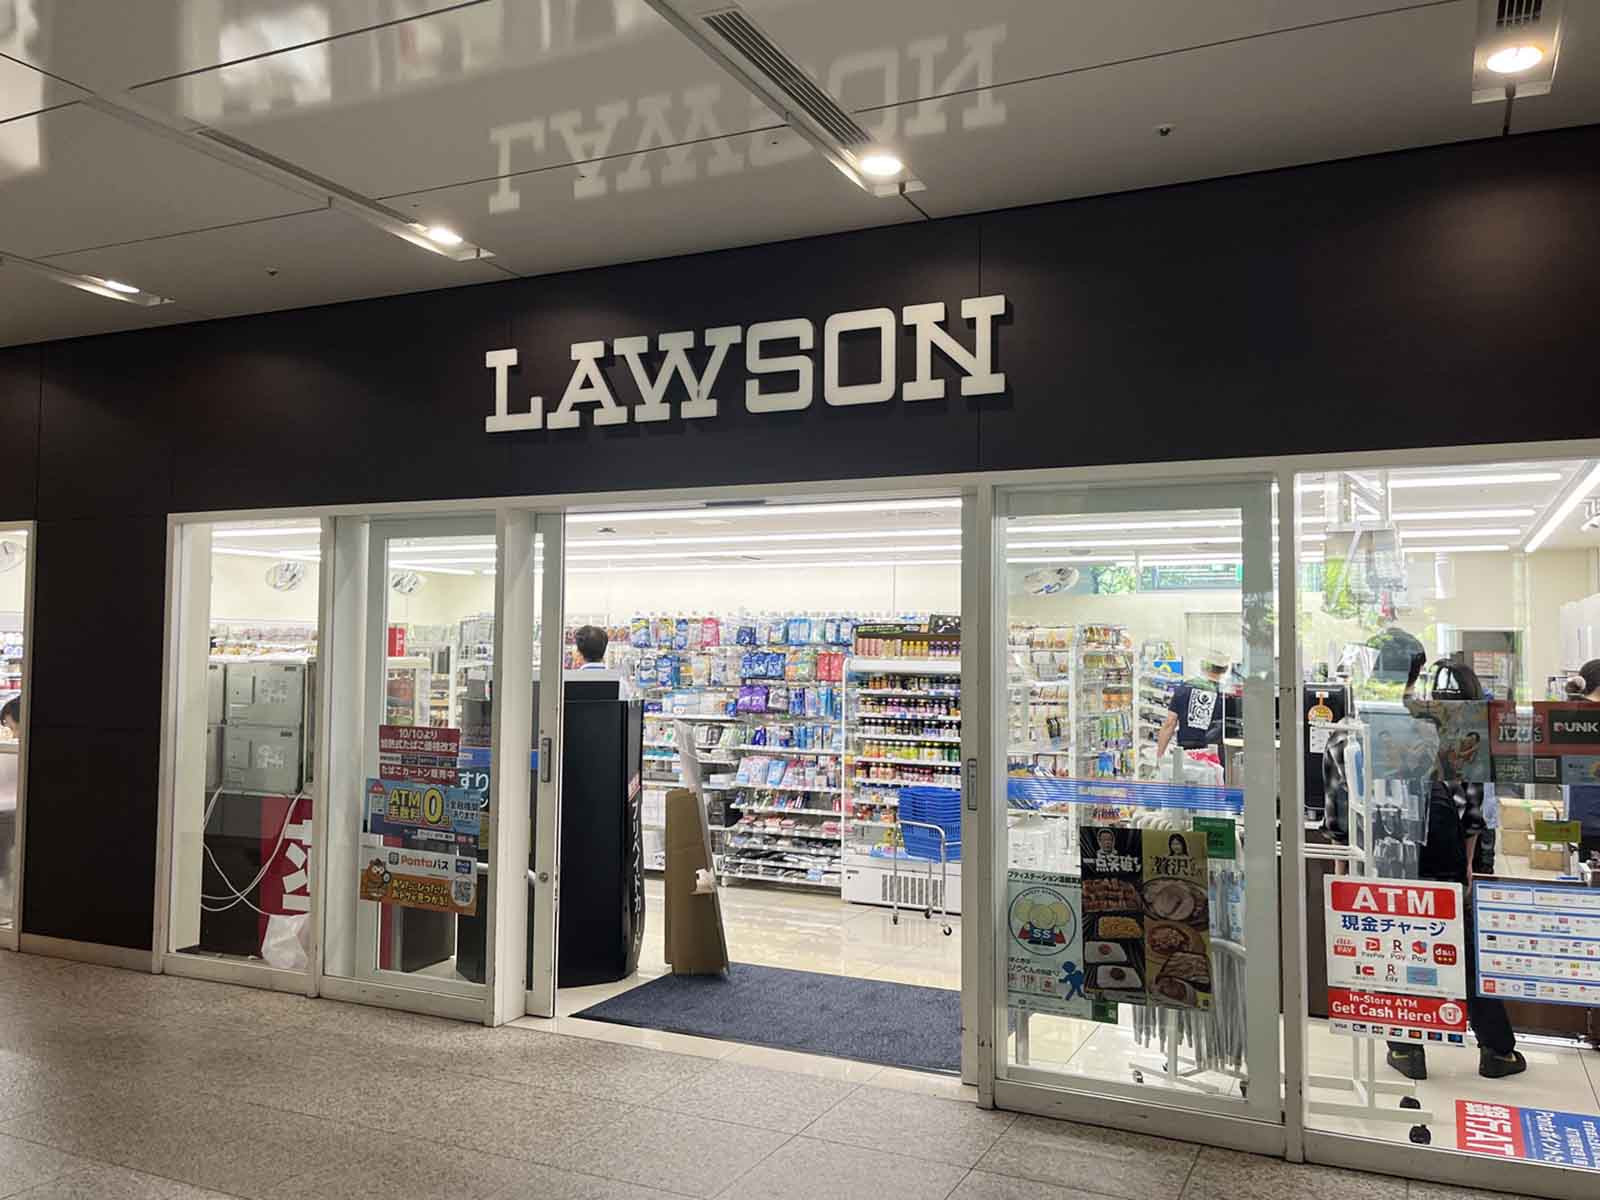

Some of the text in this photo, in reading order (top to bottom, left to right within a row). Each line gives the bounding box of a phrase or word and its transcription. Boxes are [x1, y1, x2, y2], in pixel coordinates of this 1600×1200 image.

[485, 295, 1005, 432] LAWSON
[399, 728, 438, 740] 10/10より
[390, 788, 420, 807] ATM
[401, 855, 449, 869] Pontaパス
[1352, 886, 1435, 915] ATM
[1341, 914, 1447, 936] 現金チャージ
[1033, 929, 1051, 939] SS
[1412, 954, 1428, 963] Pay
[1349, 992, 1418, 1008] In-Store ATM
[1332, 1001, 1437, 1024] Get Cash Here!
